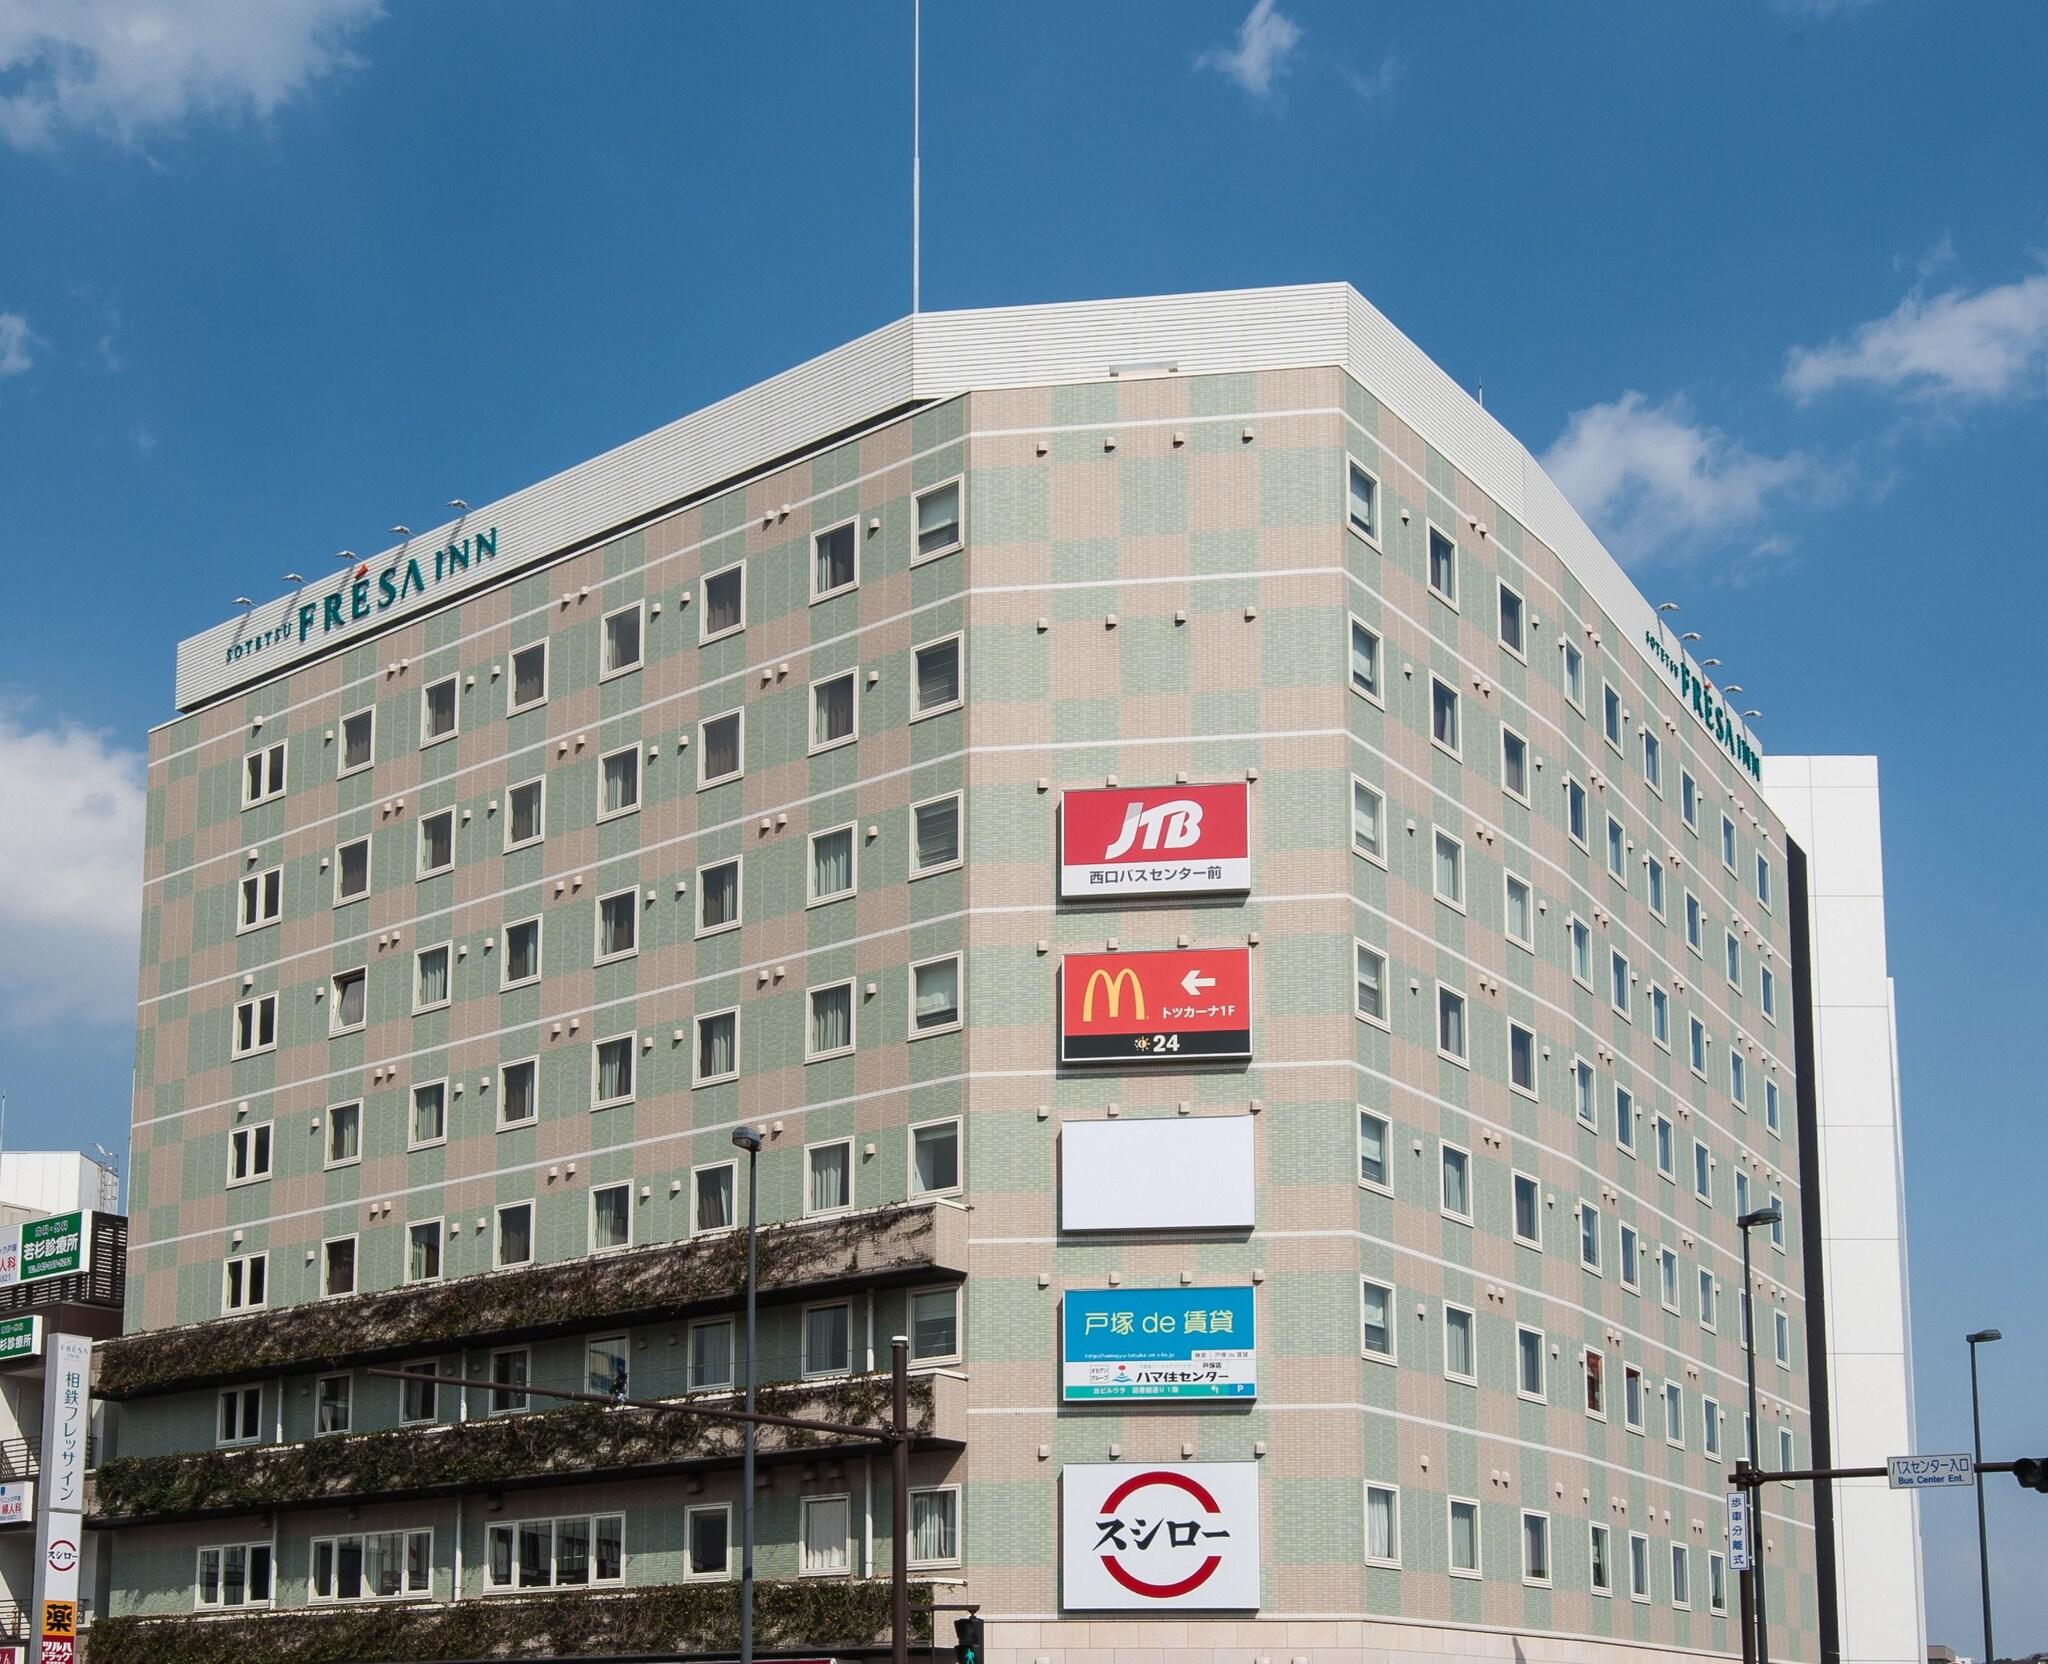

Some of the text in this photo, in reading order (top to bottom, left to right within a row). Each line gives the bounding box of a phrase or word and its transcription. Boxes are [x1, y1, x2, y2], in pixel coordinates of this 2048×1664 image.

[226, 622, 293, 663] SOTETSU
[435, 527, 497, 581] INN
[1104, 800, 1204, 860] JTB
[1089, 865, 1222, 885] 西口バスセンター前
[1153, 1034, 1180, 1053] 24
[23, 1232, 79, 1261] 若杉診療所
[1084, 1309, 1234, 1336] 戸塚 de 賃貸
[1136, 1371, 1229, 1384] ハマ住センター
[60, 1370, 81, 1502] 相鉄フレッサイン
[1892, 1458, 1969, 1475] バスセンター入口
[1898, 1475, 1914, 1485] Bus
[1917, 1475, 1944, 1484] Center
[1092, 1516, 1231, 1551] スシロー
[1730, 1497, 1745, 1565] 歩車分離式
[48, 1551, 78, 1560] スシロー
[46, 1603, 73, 1632] 薬
[41, 1651, 73, 1662] ドラッグ
[42, 1641, 73, 1652] ツルハ
